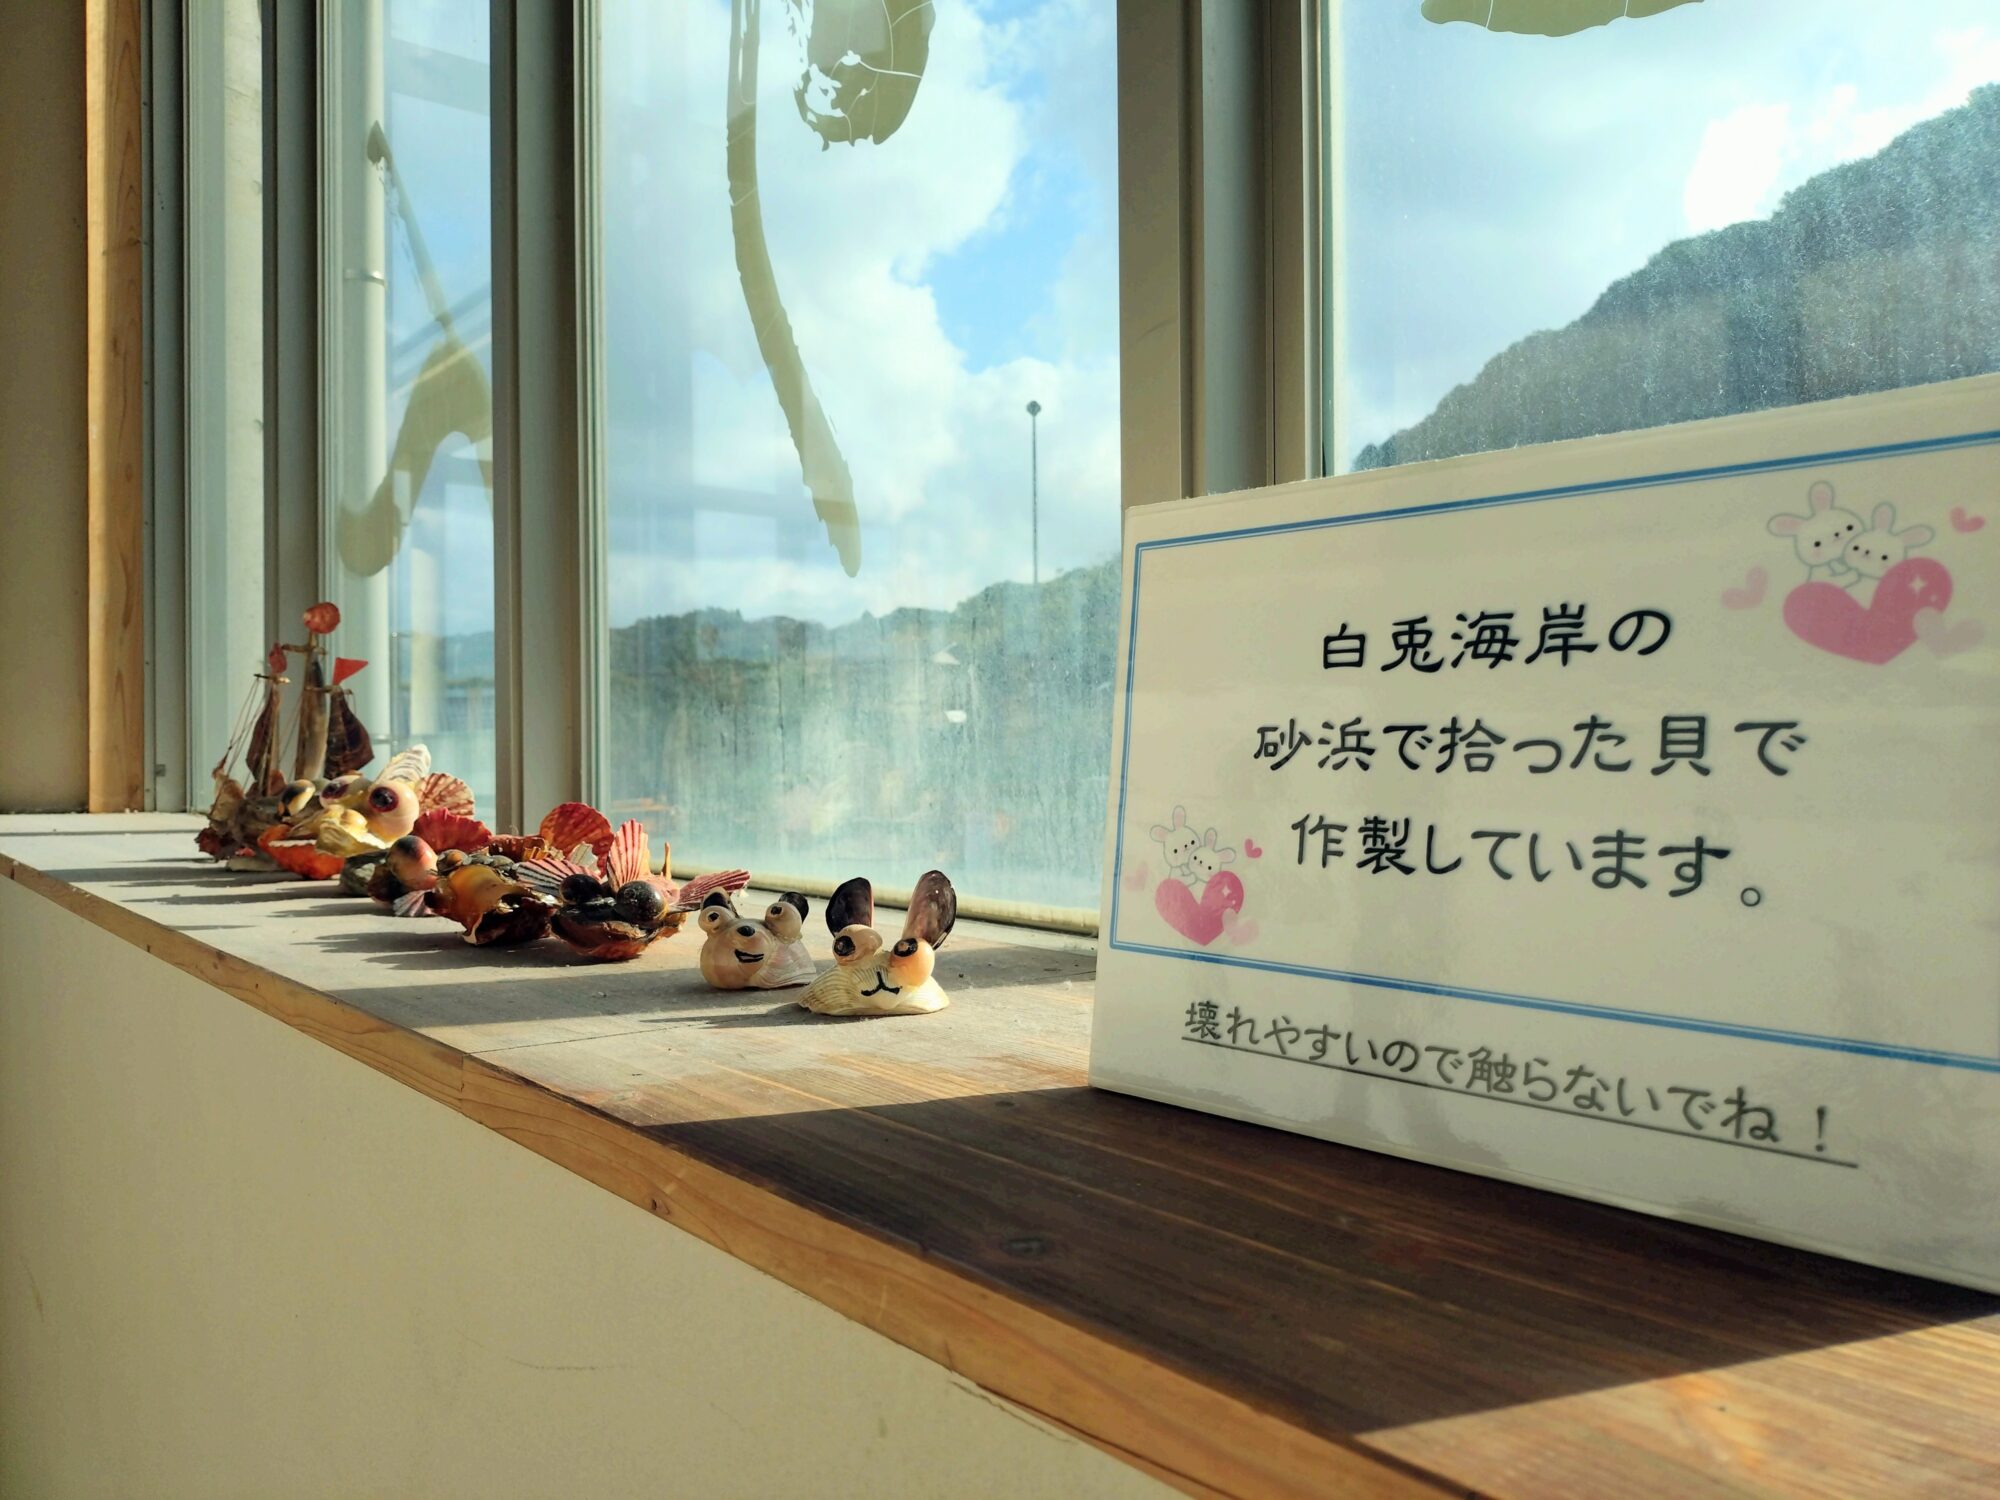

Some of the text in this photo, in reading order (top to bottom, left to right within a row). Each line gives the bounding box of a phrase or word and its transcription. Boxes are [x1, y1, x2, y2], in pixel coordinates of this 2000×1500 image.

[1321, 602, 1673, 673] 白兎海岸の
[1253, 714, 1807, 777] 砂浜で拾った貝で
[1291, 813, 1763, 908] 作製しています。
[1184, 1000, 1828, 1153] 壊れやすいので触らないでね！
